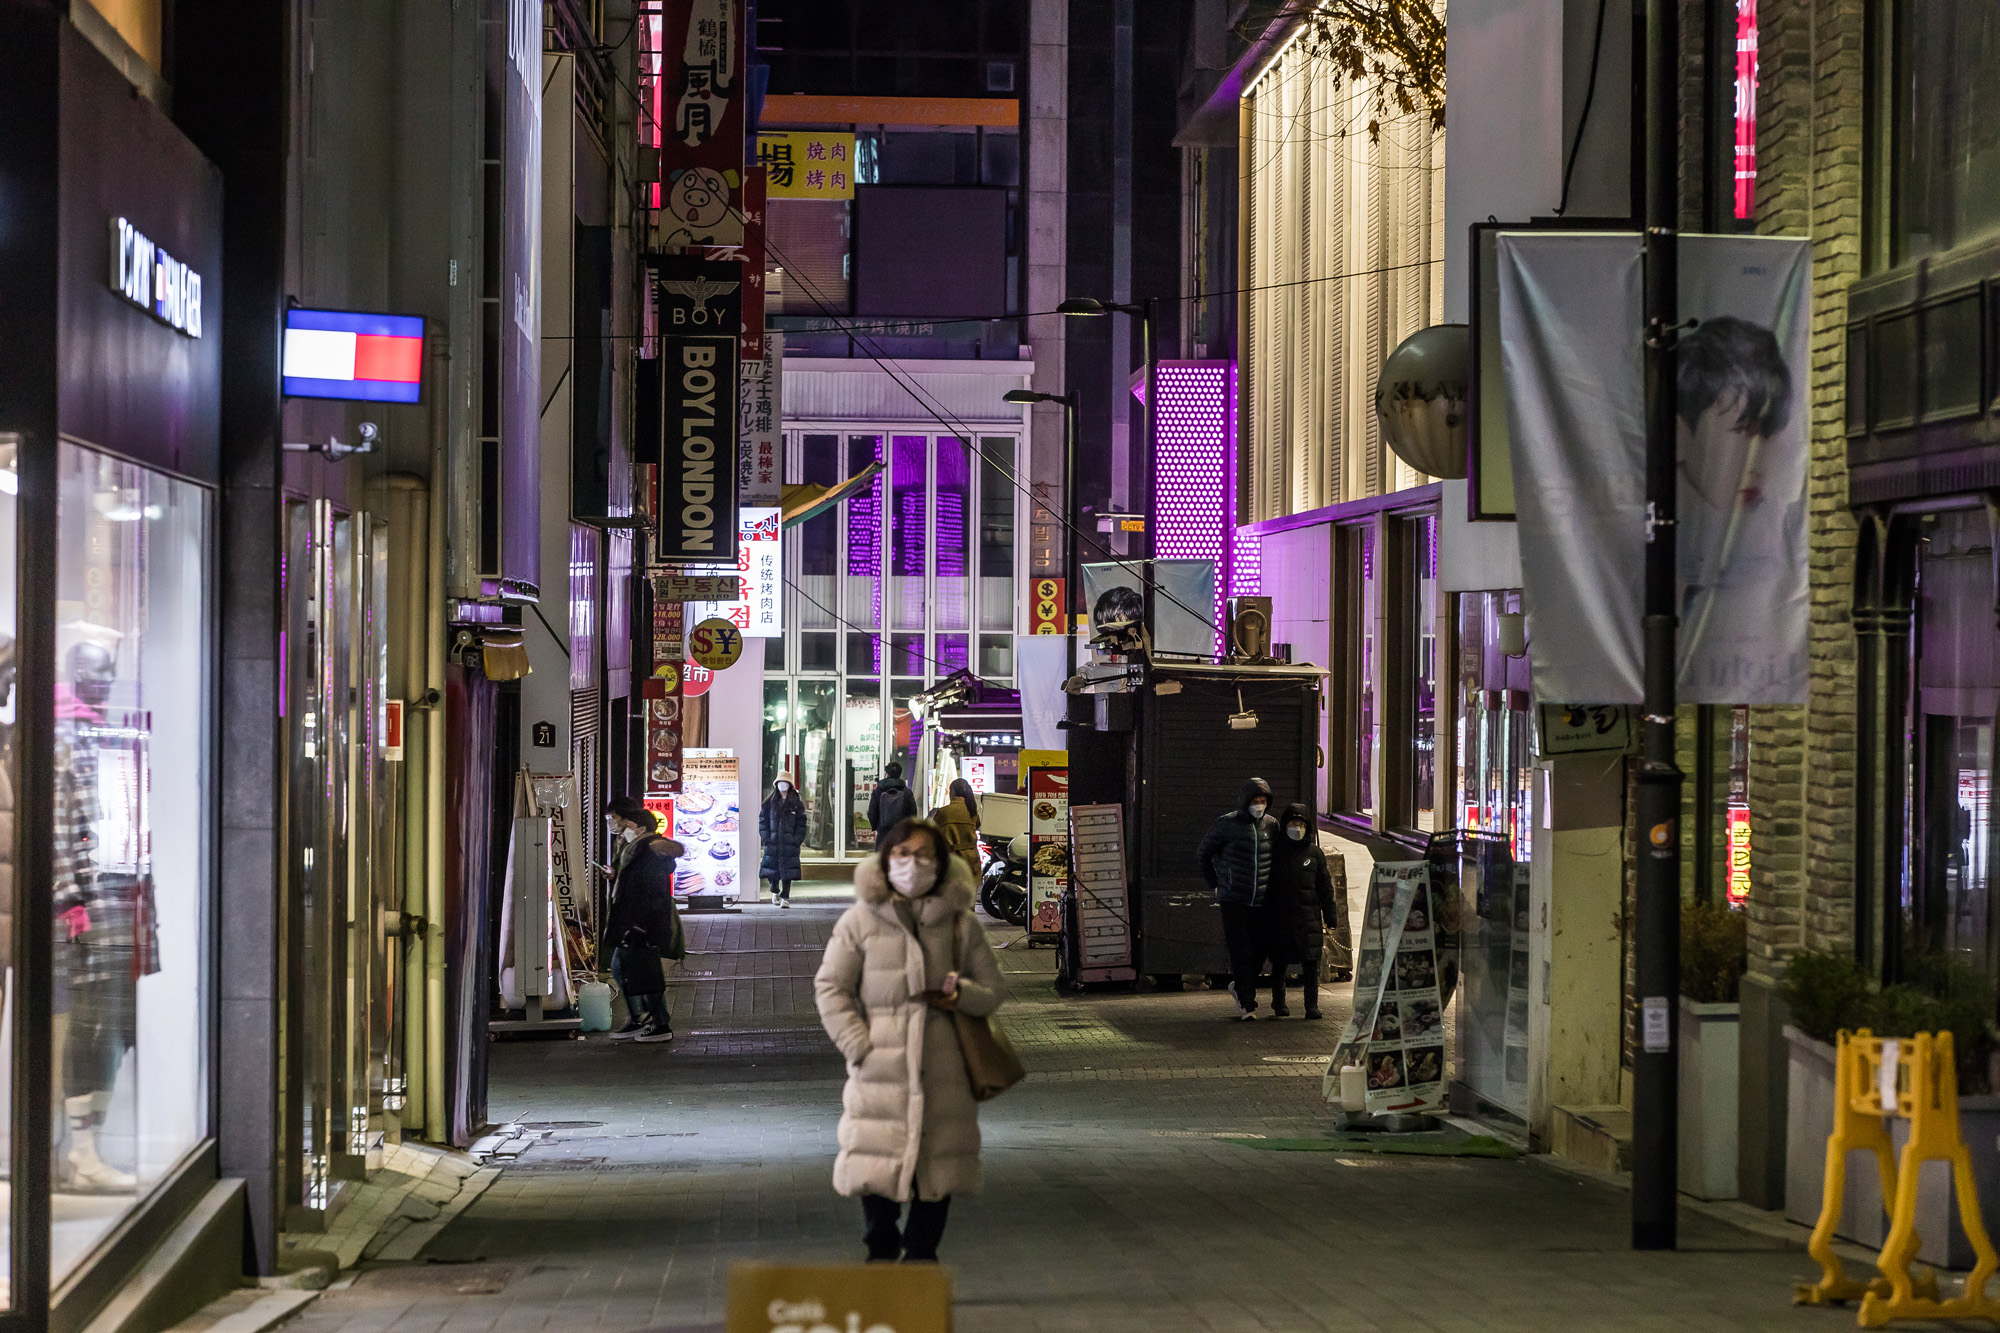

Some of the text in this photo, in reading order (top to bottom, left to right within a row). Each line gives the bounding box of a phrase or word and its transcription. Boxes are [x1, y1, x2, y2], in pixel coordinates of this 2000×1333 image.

[698, 18, 717, 57] 鶴橋
[670, 58, 735, 142] 風月
[806, 141, 847, 162] 焼肉
[806, 169, 847, 190] 烤肉
[673, 308, 726, 325] BOY
[671, 577, 736, 594] 부동산
[760, 554, 774, 624] 传统烤肉店
[1041, 582, 1053, 597] $
[1041, 603, 1053, 617] ¥
[539, 731, 550, 744] 21
[550, 805, 575, 919] 선지해장국
